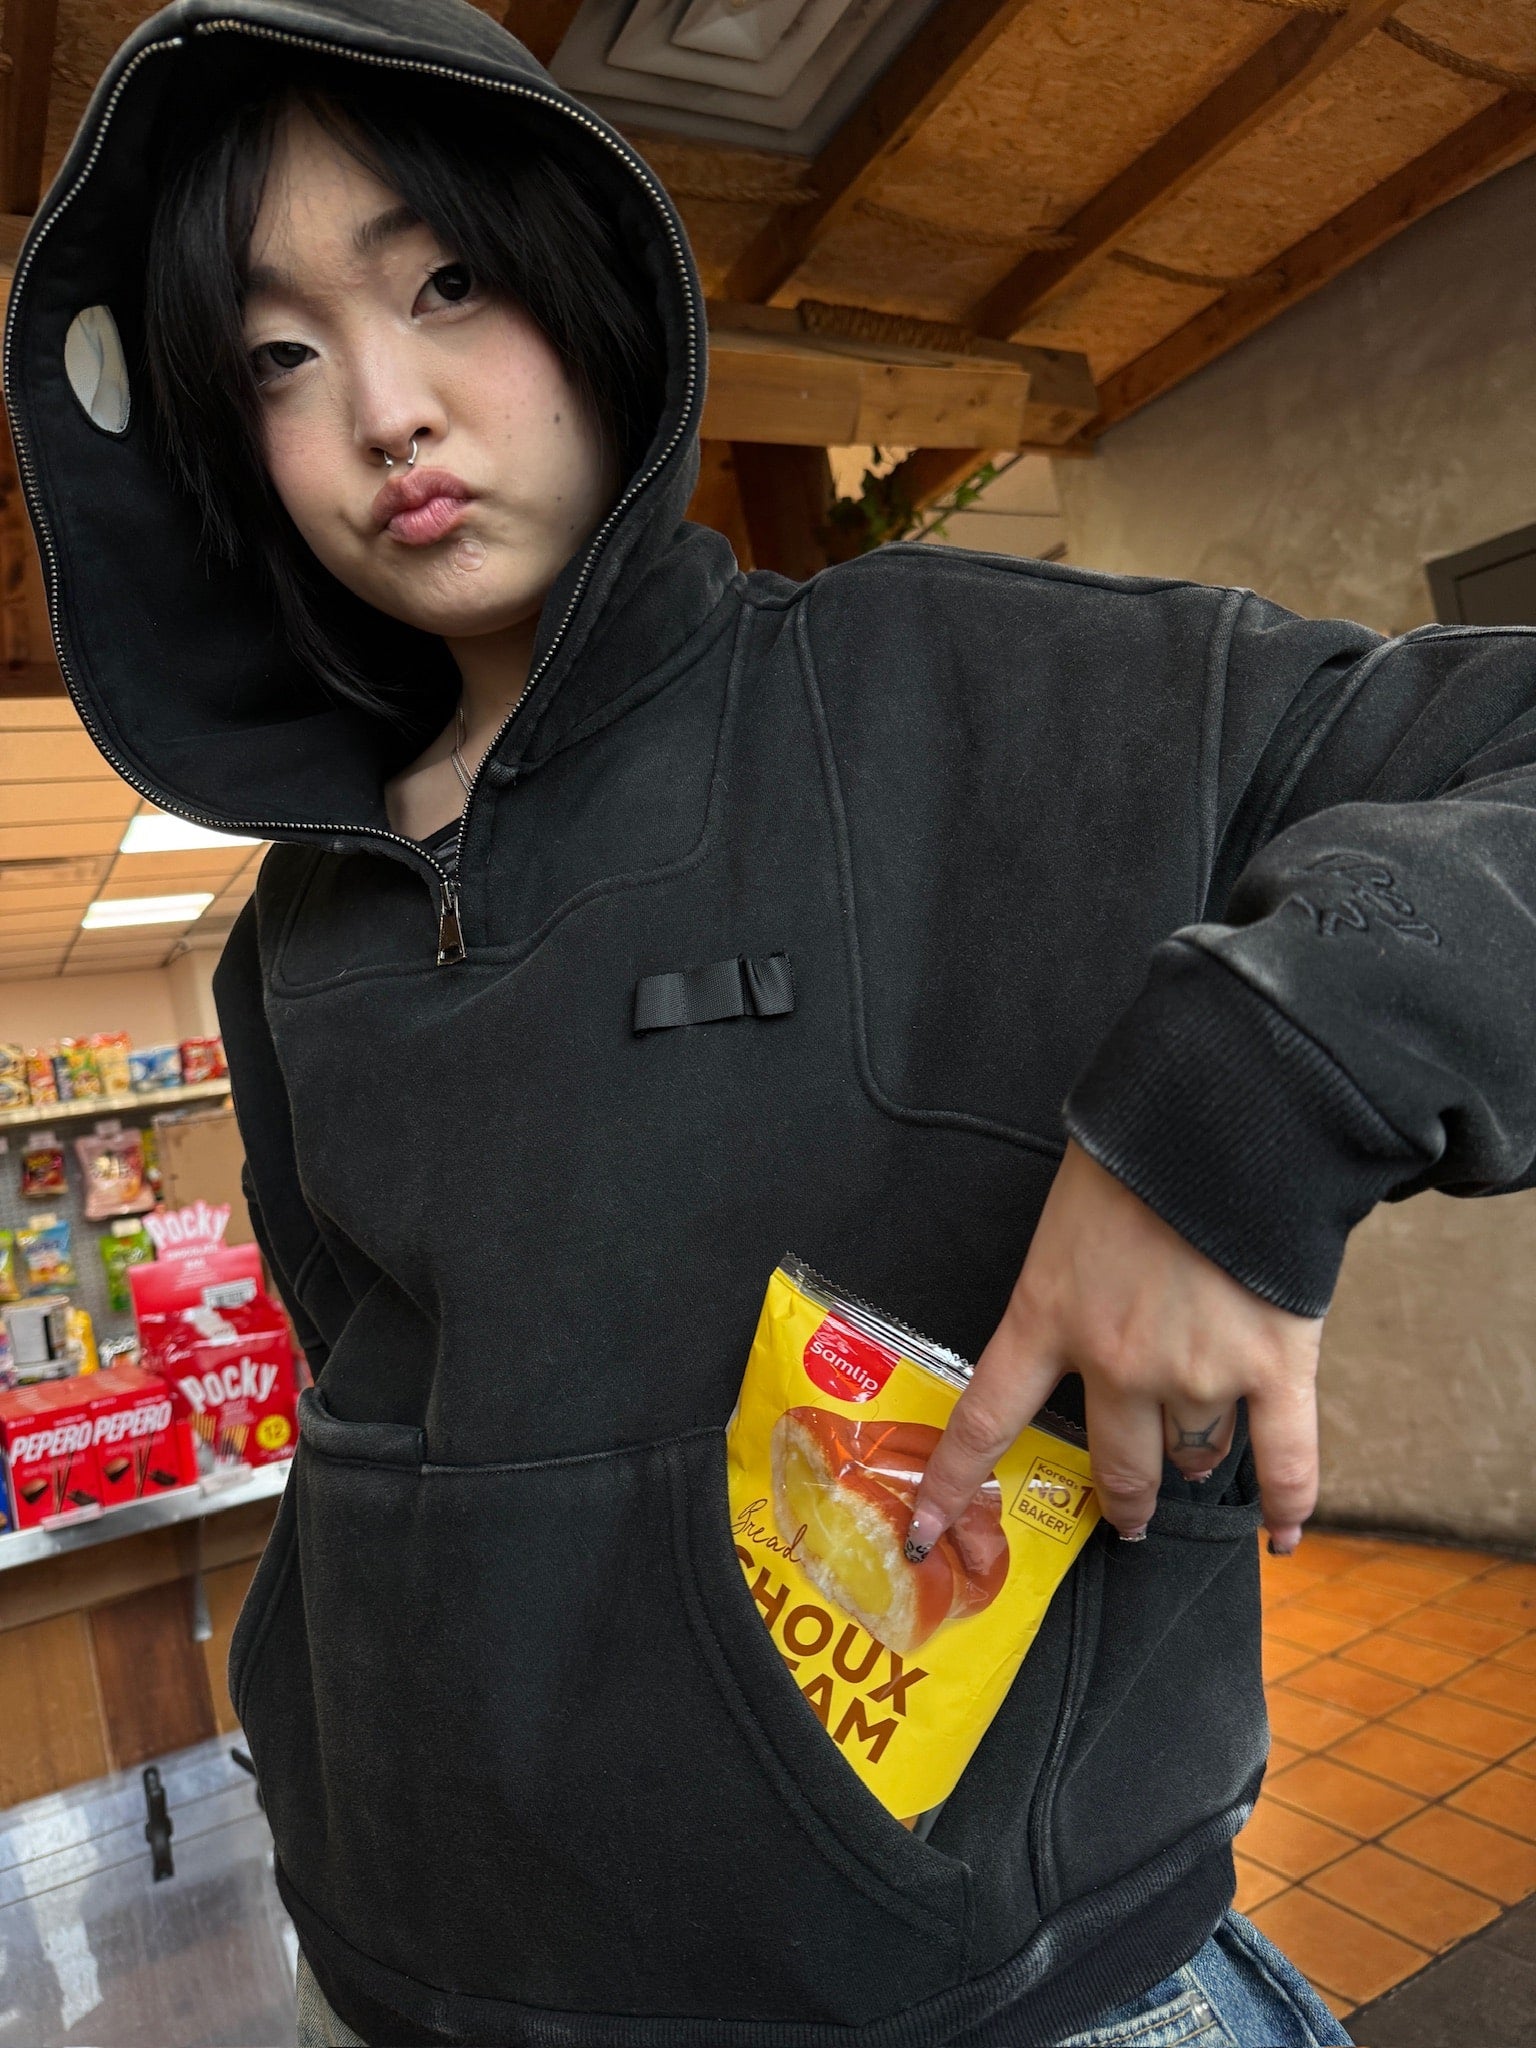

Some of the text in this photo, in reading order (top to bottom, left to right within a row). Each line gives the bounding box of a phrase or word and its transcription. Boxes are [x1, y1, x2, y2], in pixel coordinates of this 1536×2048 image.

[810, 1341, 878, 1391] samlip
[9, 1420, 93, 1468] PEPERO
[92, 1400, 173, 1446] PEPERO
[731, 1498, 808, 1563] Bread
[1018, 1499, 1073, 1535] BAKERY
